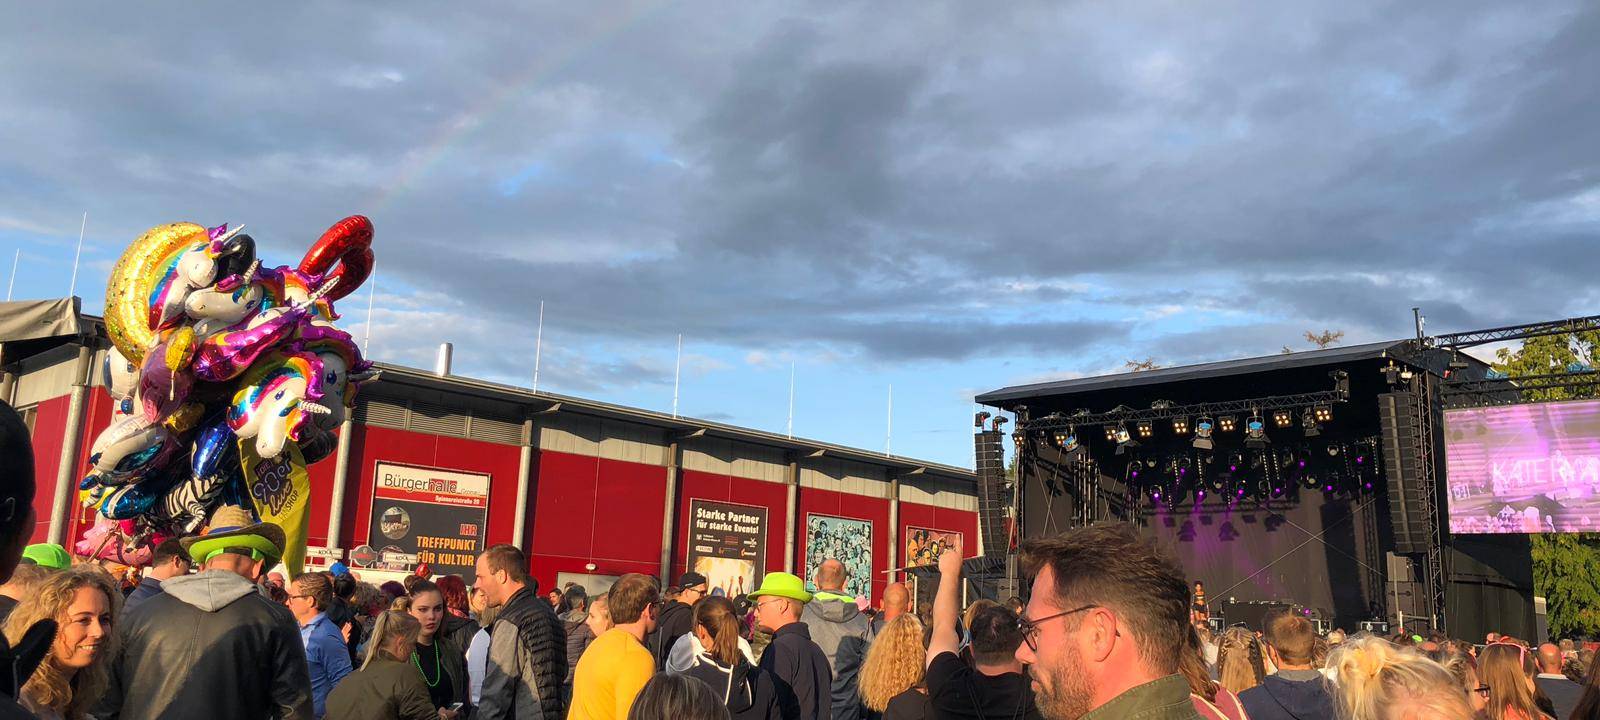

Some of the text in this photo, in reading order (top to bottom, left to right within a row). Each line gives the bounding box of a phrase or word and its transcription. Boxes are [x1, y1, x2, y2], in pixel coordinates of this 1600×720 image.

[384, 473, 458, 494] Bürgerhalle
[697, 508, 759, 524] Starke Partner
[696, 519, 759, 533] für starke Events!
[416, 535, 477, 551] TREFFPUNKT
[417, 550, 475, 566] FÜR KULTUR
